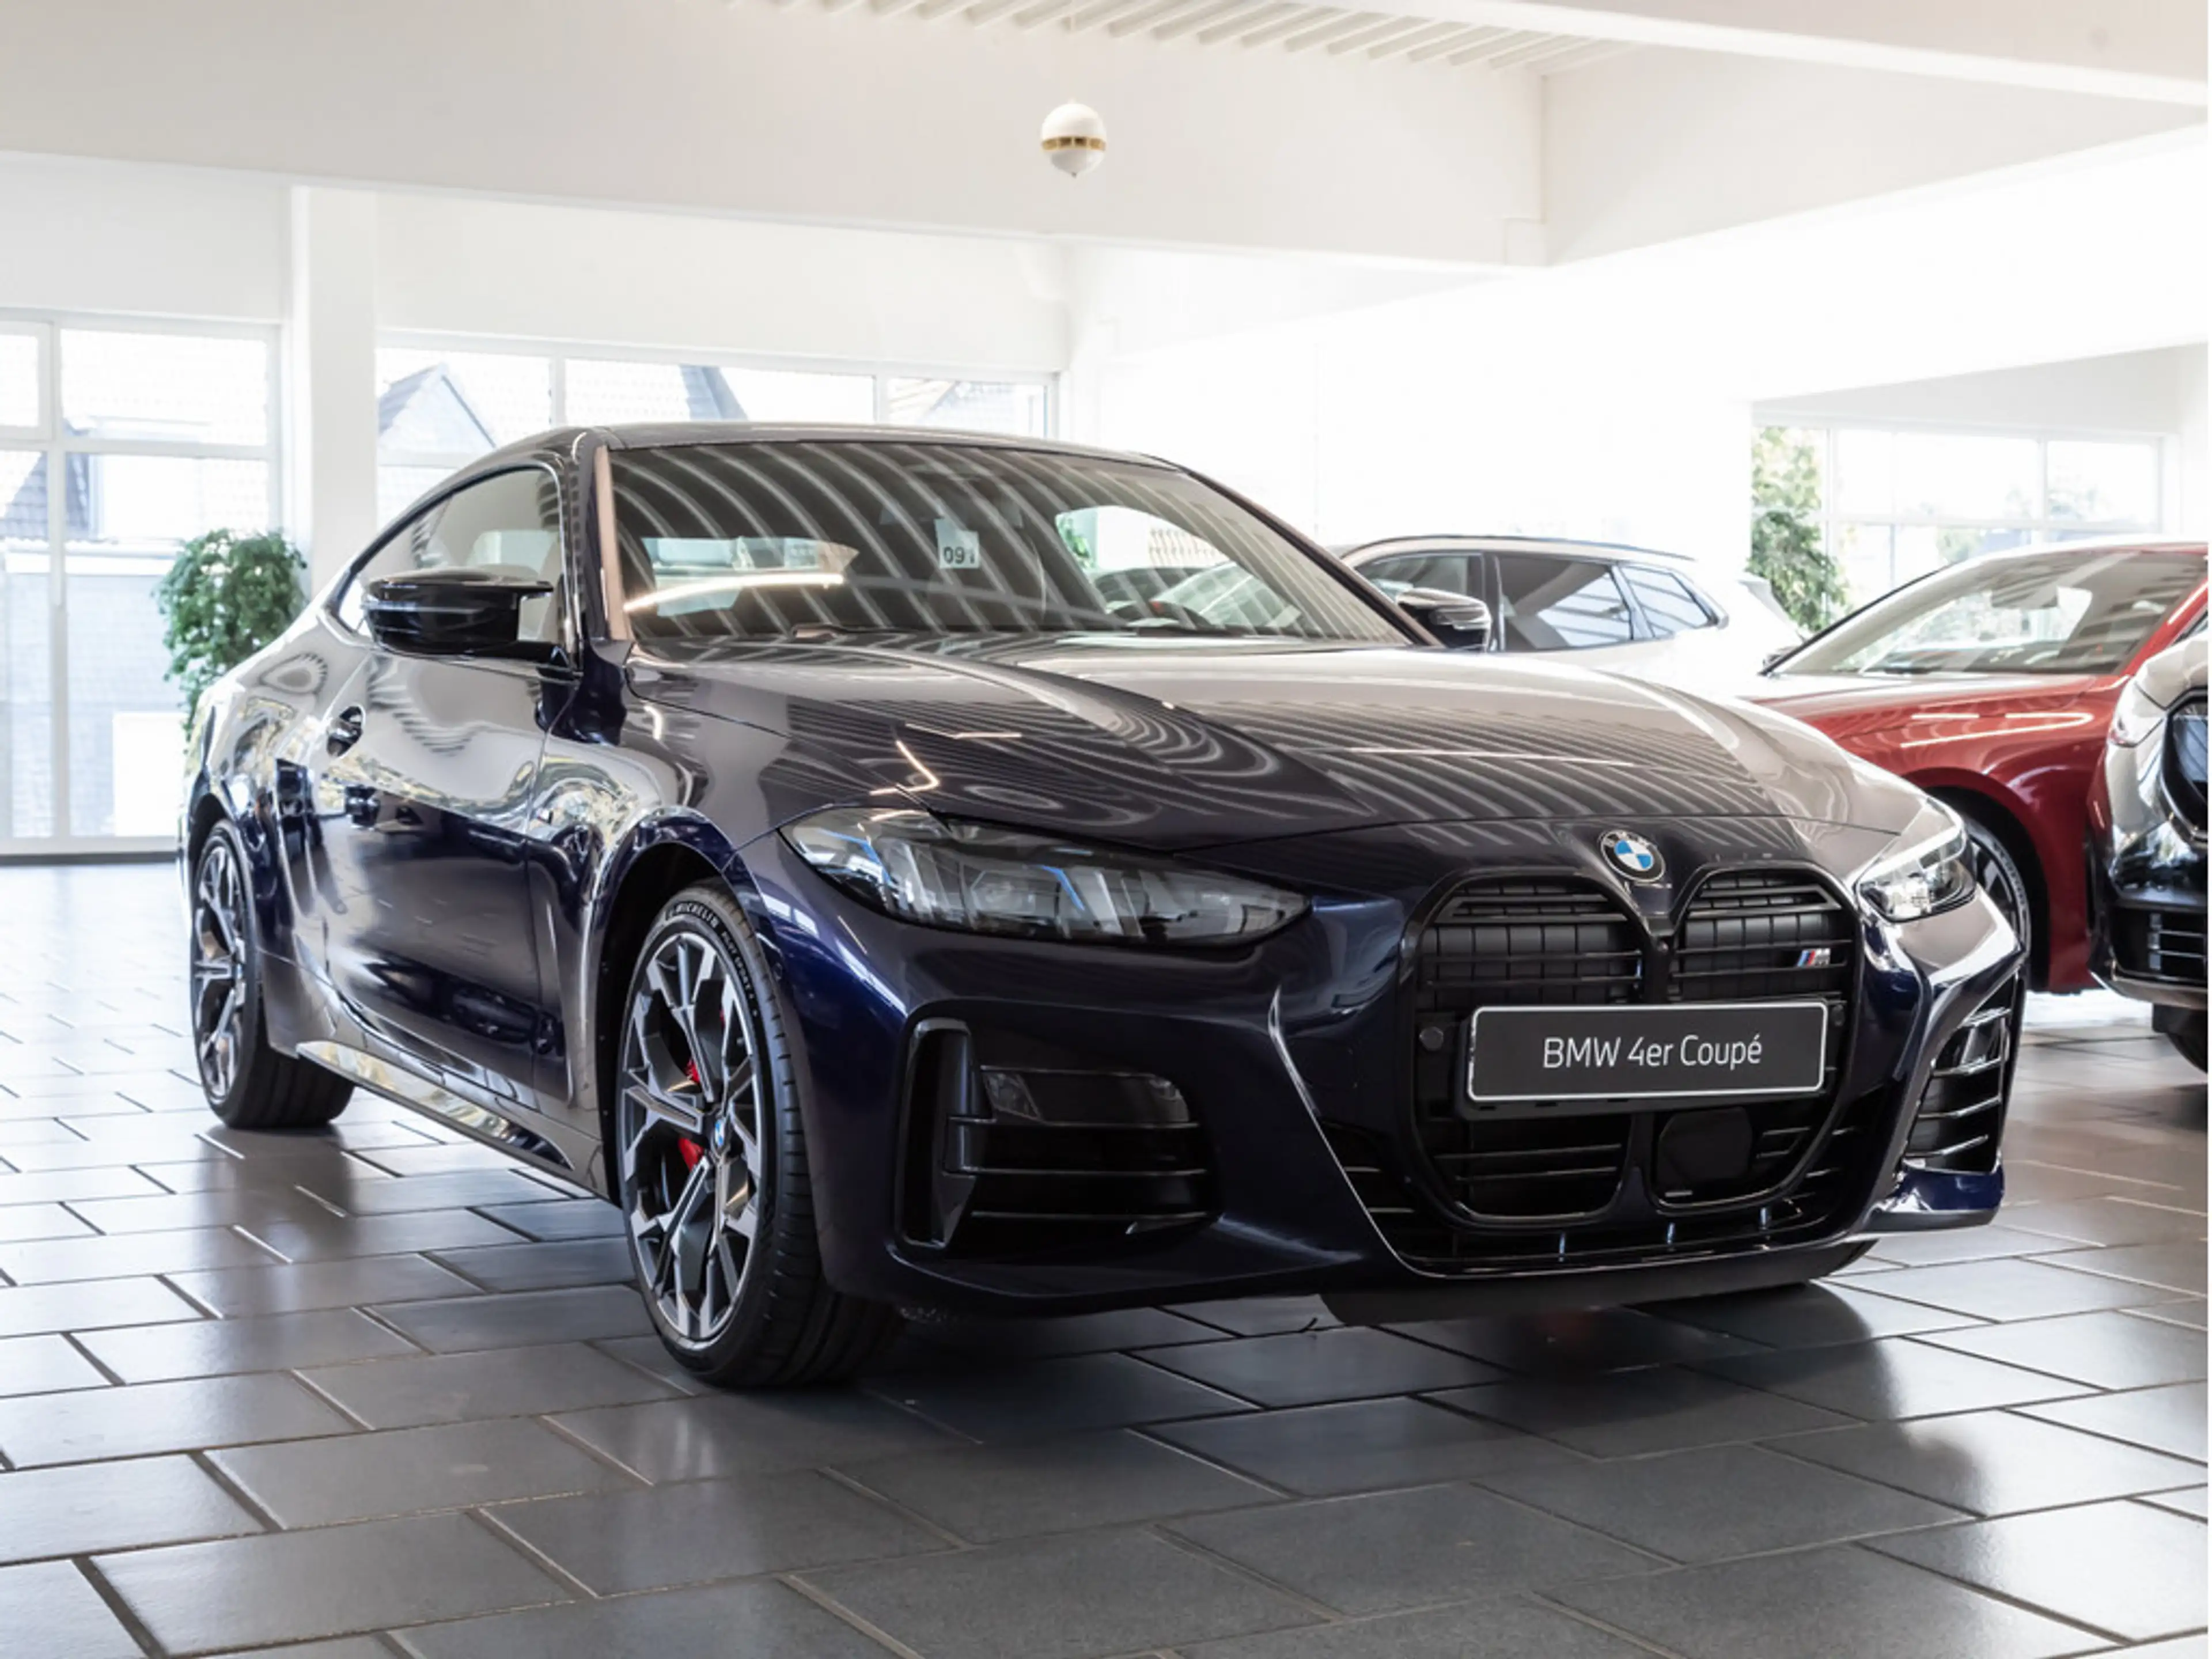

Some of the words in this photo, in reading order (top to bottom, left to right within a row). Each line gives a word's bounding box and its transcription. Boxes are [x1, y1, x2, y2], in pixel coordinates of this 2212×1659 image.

[1543, 1036, 1622, 1069] BMW
[1627, 1036, 1675, 1067] 4er
[1680, 1032, 1762, 1071] Coupé
